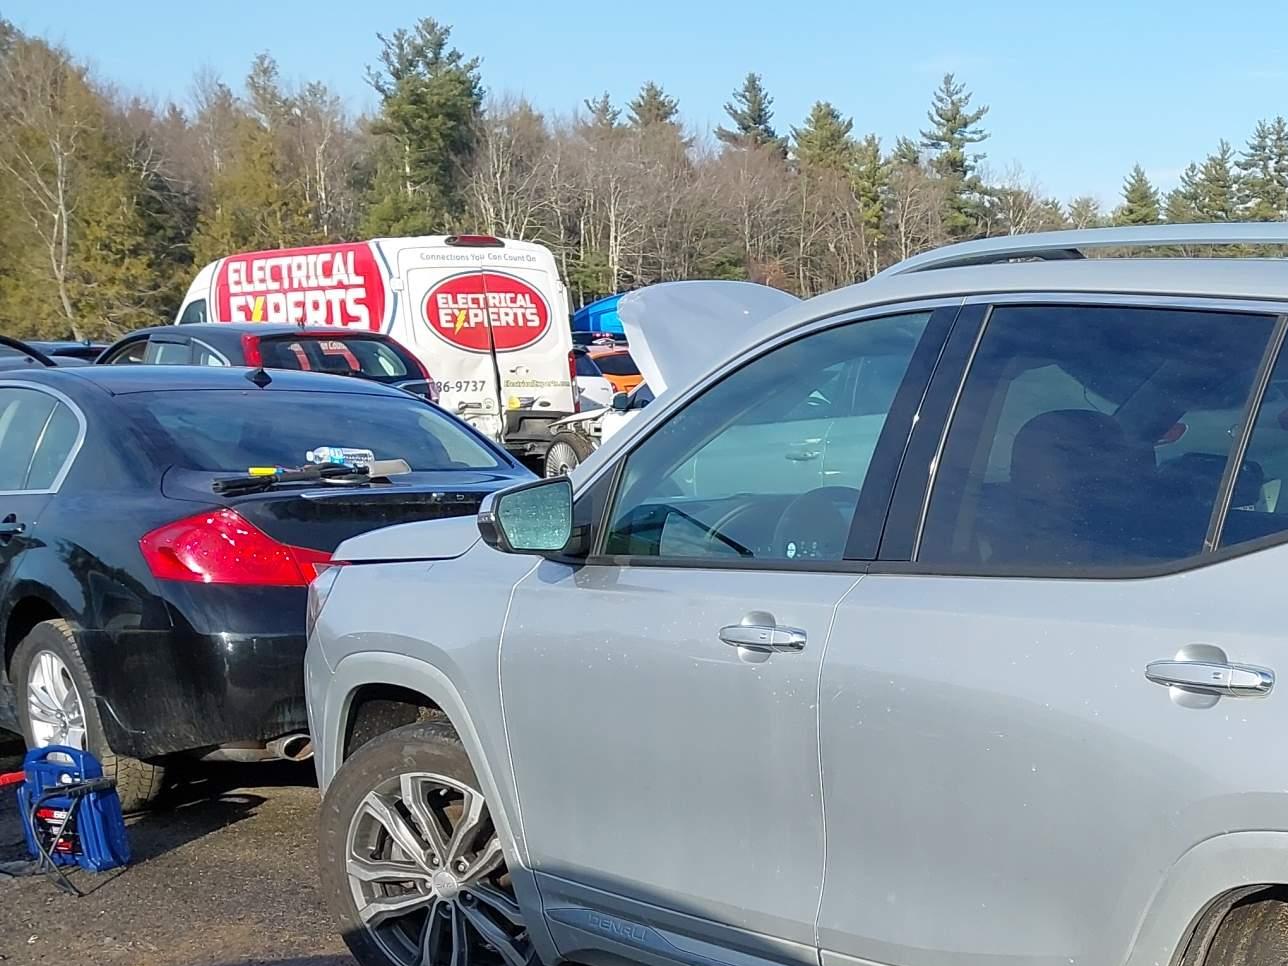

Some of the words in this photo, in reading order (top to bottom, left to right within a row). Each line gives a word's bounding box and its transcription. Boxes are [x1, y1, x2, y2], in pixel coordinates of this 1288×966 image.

[420, 252, 469, 261] Connections
[470, 253, 485, 261] You
[487, 252, 503, 261] Can
[503, 254, 525, 262] Count
[525, 254, 537, 262] On
[227, 250, 365, 293] ELECTRICAL
[436, 292, 536, 309] ELECTRICAL
[438, 307, 540, 330] EXPERTS
[588, 912, 647, 944] DENALI
